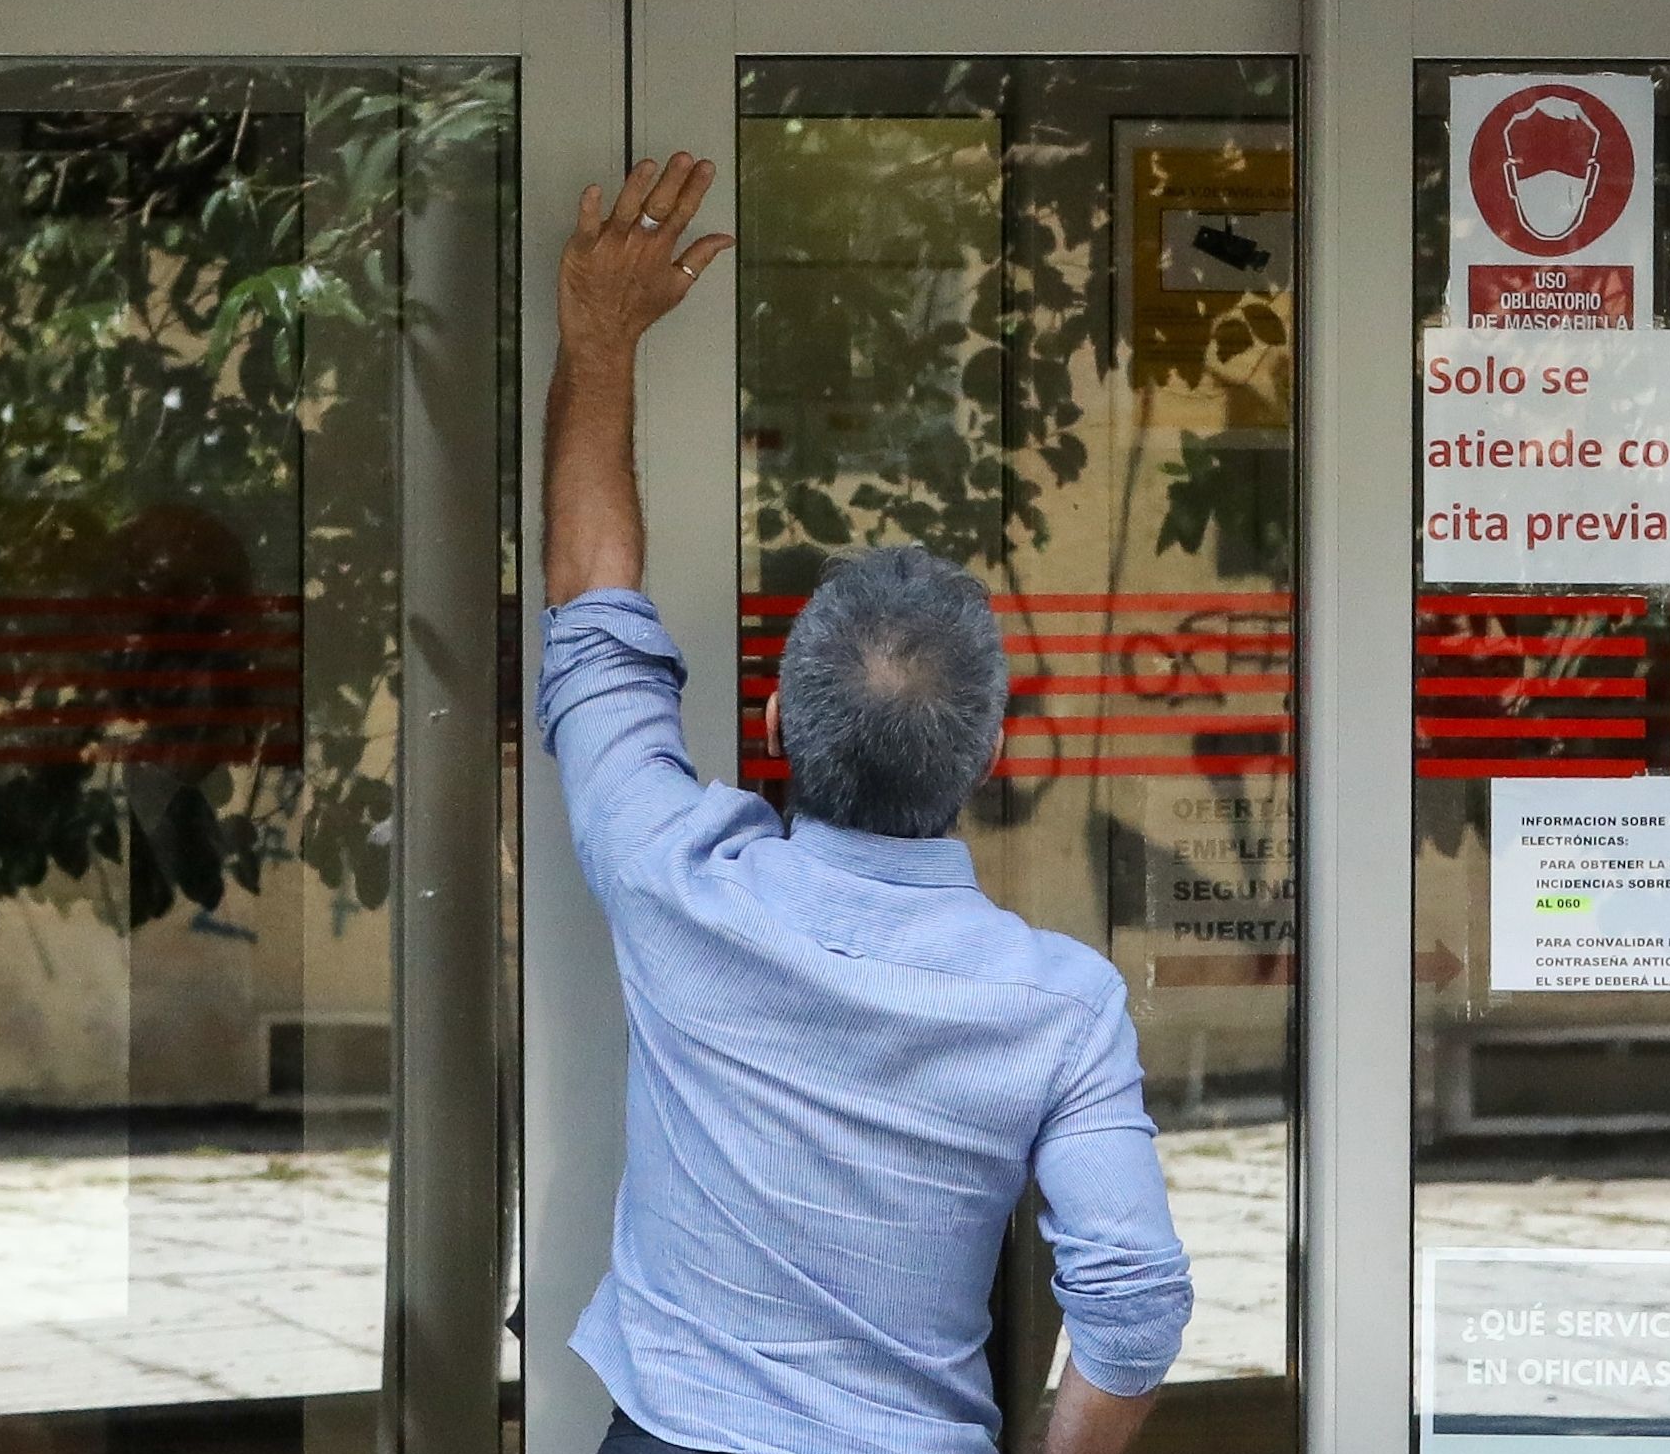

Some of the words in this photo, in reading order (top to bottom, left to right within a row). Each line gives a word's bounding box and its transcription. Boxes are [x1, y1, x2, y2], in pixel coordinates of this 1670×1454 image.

[1534, 272, 1566, 288] USO
[1500, 292, 1601, 310] OBLIGATORIO
[1472, 314, 1498, 330] DE
[1428, 356, 1526, 395] Solo
[1542, 366, 1589, 395] se
[1428, 429, 1602, 468] atiende
[1428, 503, 1508, 540] cita
[1527, 503, 1668, 550] previa
[1172, 798, 1295, 819] OFERTA
[1621, 816, 1666, 826] SOBRE
[1521, 835, 1629, 846] ELECTRÓNICAS:
[1540, 859, 1576, 870] PARA
[1581, 859, 1644, 870] OBTENER
[1649, 859, 1666, 870] LA
[1536, 878, 1624, 889] INCIDENCIAS
[1536, 898, 1553, 909] AL
[1557, 898, 1581, 909] 060
[1174, 921, 1296, 942] PUERTA
[1536, 937, 1572, 948] PARA
[1576, 937, 1664, 948] CONVALIDAR
[1535, 954, 1628, 967] CONTRASEÑA
[1536, 976, 1552, 987] EL
[1556, 976, 1591, 987] SEPE
[1595, 973, 1649, 987] DEBERÁ
[1461, 1302, 1547, 1342] ¿QUÉ
[1466, 1358, 1507, 1388] EN
